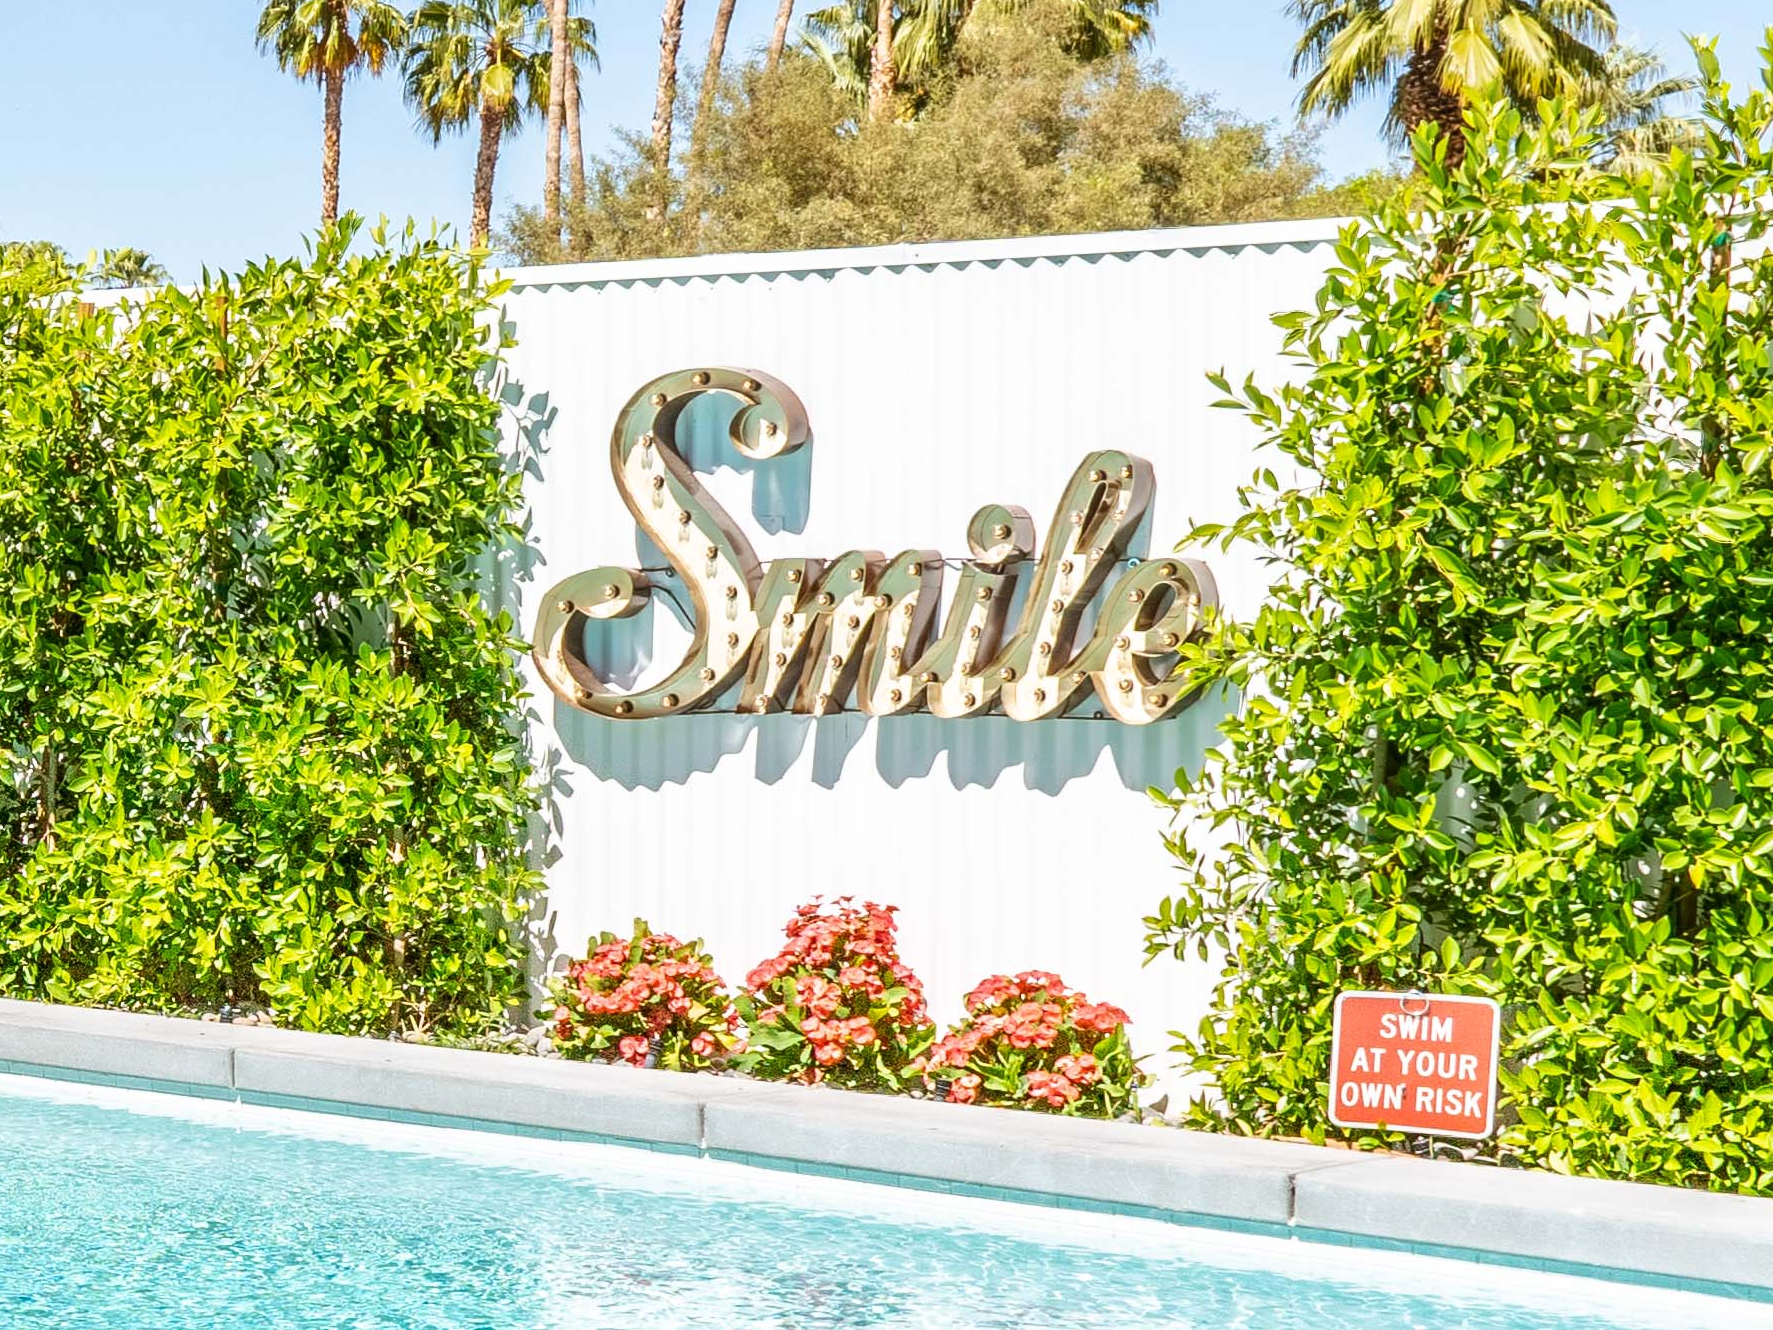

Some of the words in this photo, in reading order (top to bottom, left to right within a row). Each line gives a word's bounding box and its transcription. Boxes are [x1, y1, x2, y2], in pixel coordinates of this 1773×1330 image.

[533, 367, 1219, 725] Smile
[1379, 1013, 1453, 1043] SWIM
[1350, 1047, 1387, 1073] AT
[1397, 1049, 1478, 1081] YOUR
[1340, 1081, 1404, 1110] OWN
[1415, 1086, 1483, 1118] RISK
